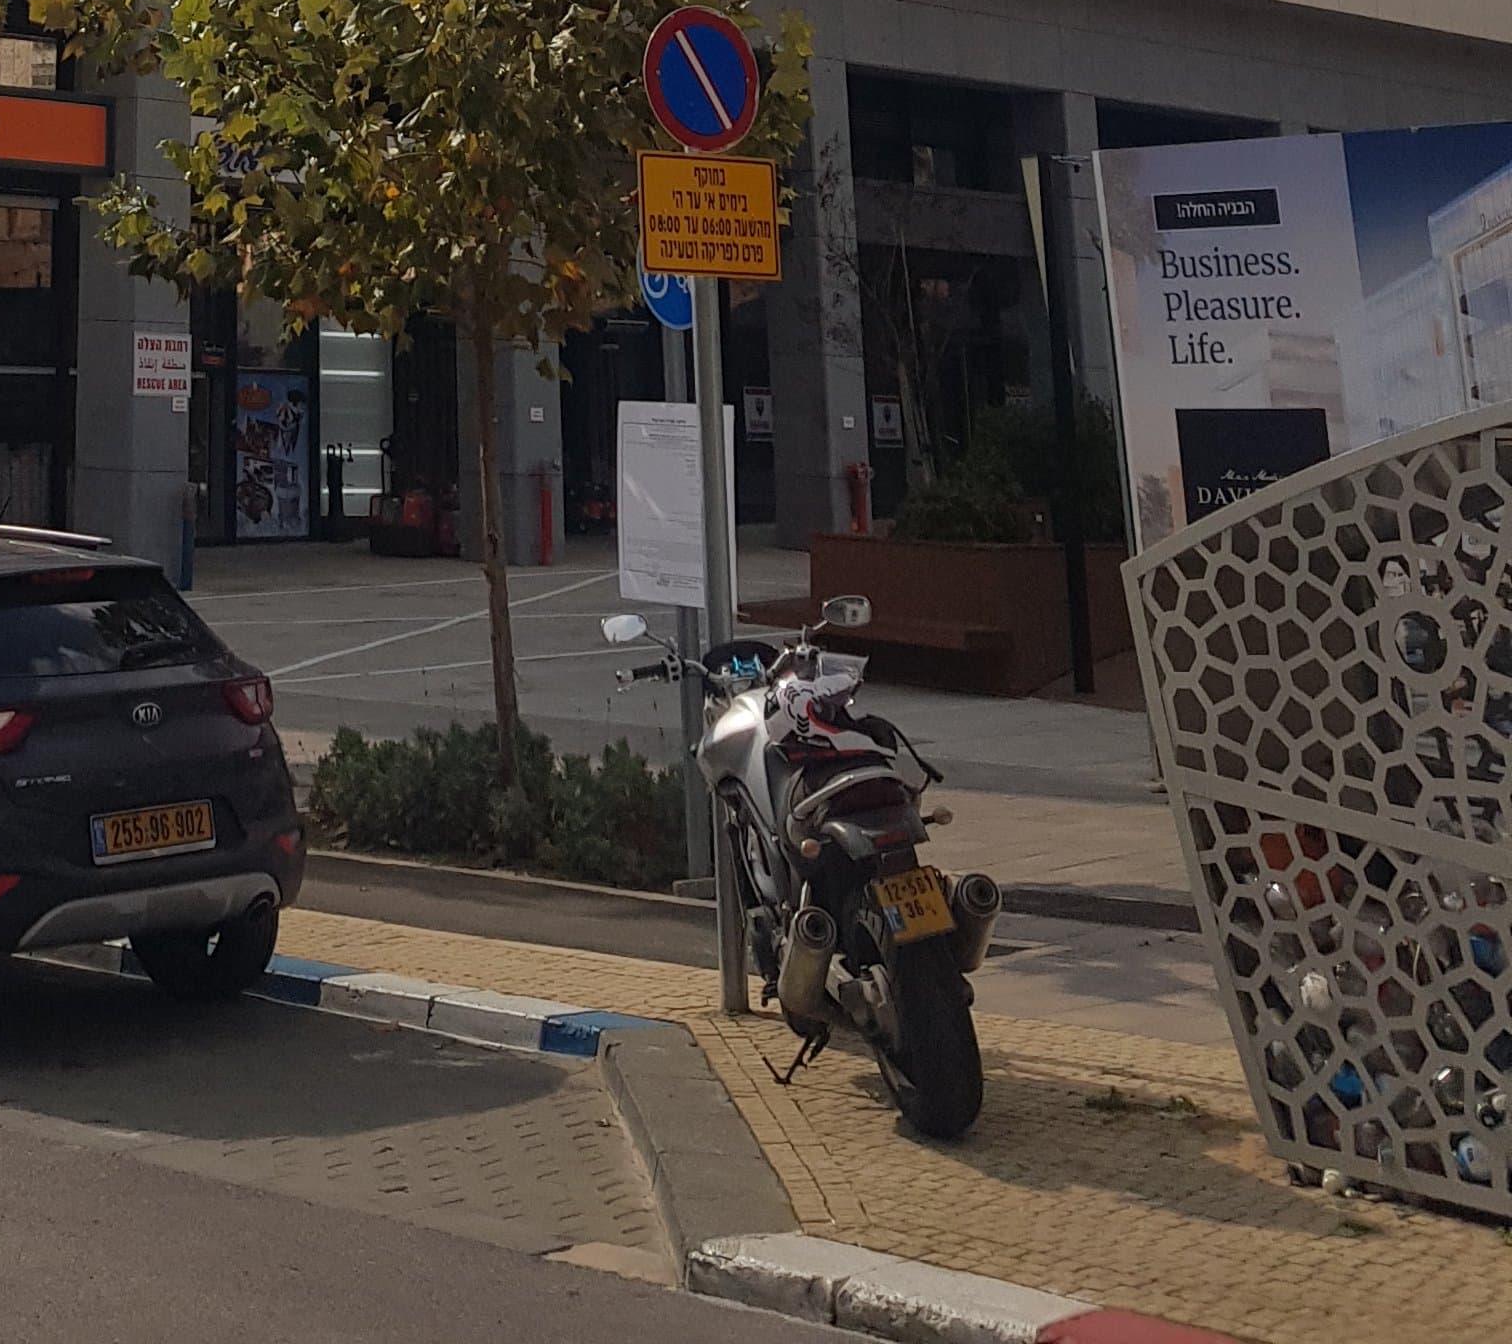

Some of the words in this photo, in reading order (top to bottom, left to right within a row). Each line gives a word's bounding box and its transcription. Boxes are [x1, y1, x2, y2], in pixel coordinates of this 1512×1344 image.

[693, 167, 726, 188] בתוקף
[686, 190, 701, 209] עד
[718, 192, 748, 212] בימים
[1217, 200, 1256, 217] הבניה
[1176, 201, 1217, 219] החלה!
[649, 214, 681, 233] 08:00
[684, 215, 699, 234] עד
[702, 217, 732, 236] 06:00
[734, 217, 771, 239] מהשעה
[660, 239, 699, 259] וטעינה
[701, 240, 739, 263] לפריקה
[742, 244, 764, 263] פרט
[1158, 246, 1300, 279] Business.
[1163, 290, 1301, 322] Pleasure.
[1168, 331, 1233, 365] Life.
[136, 377, 165, 390] RESCUE
[167, 378, 187, 390] AREA
[1197, 486, 1261, 505] DAVI
[138, 706, 160, 721] KIA
